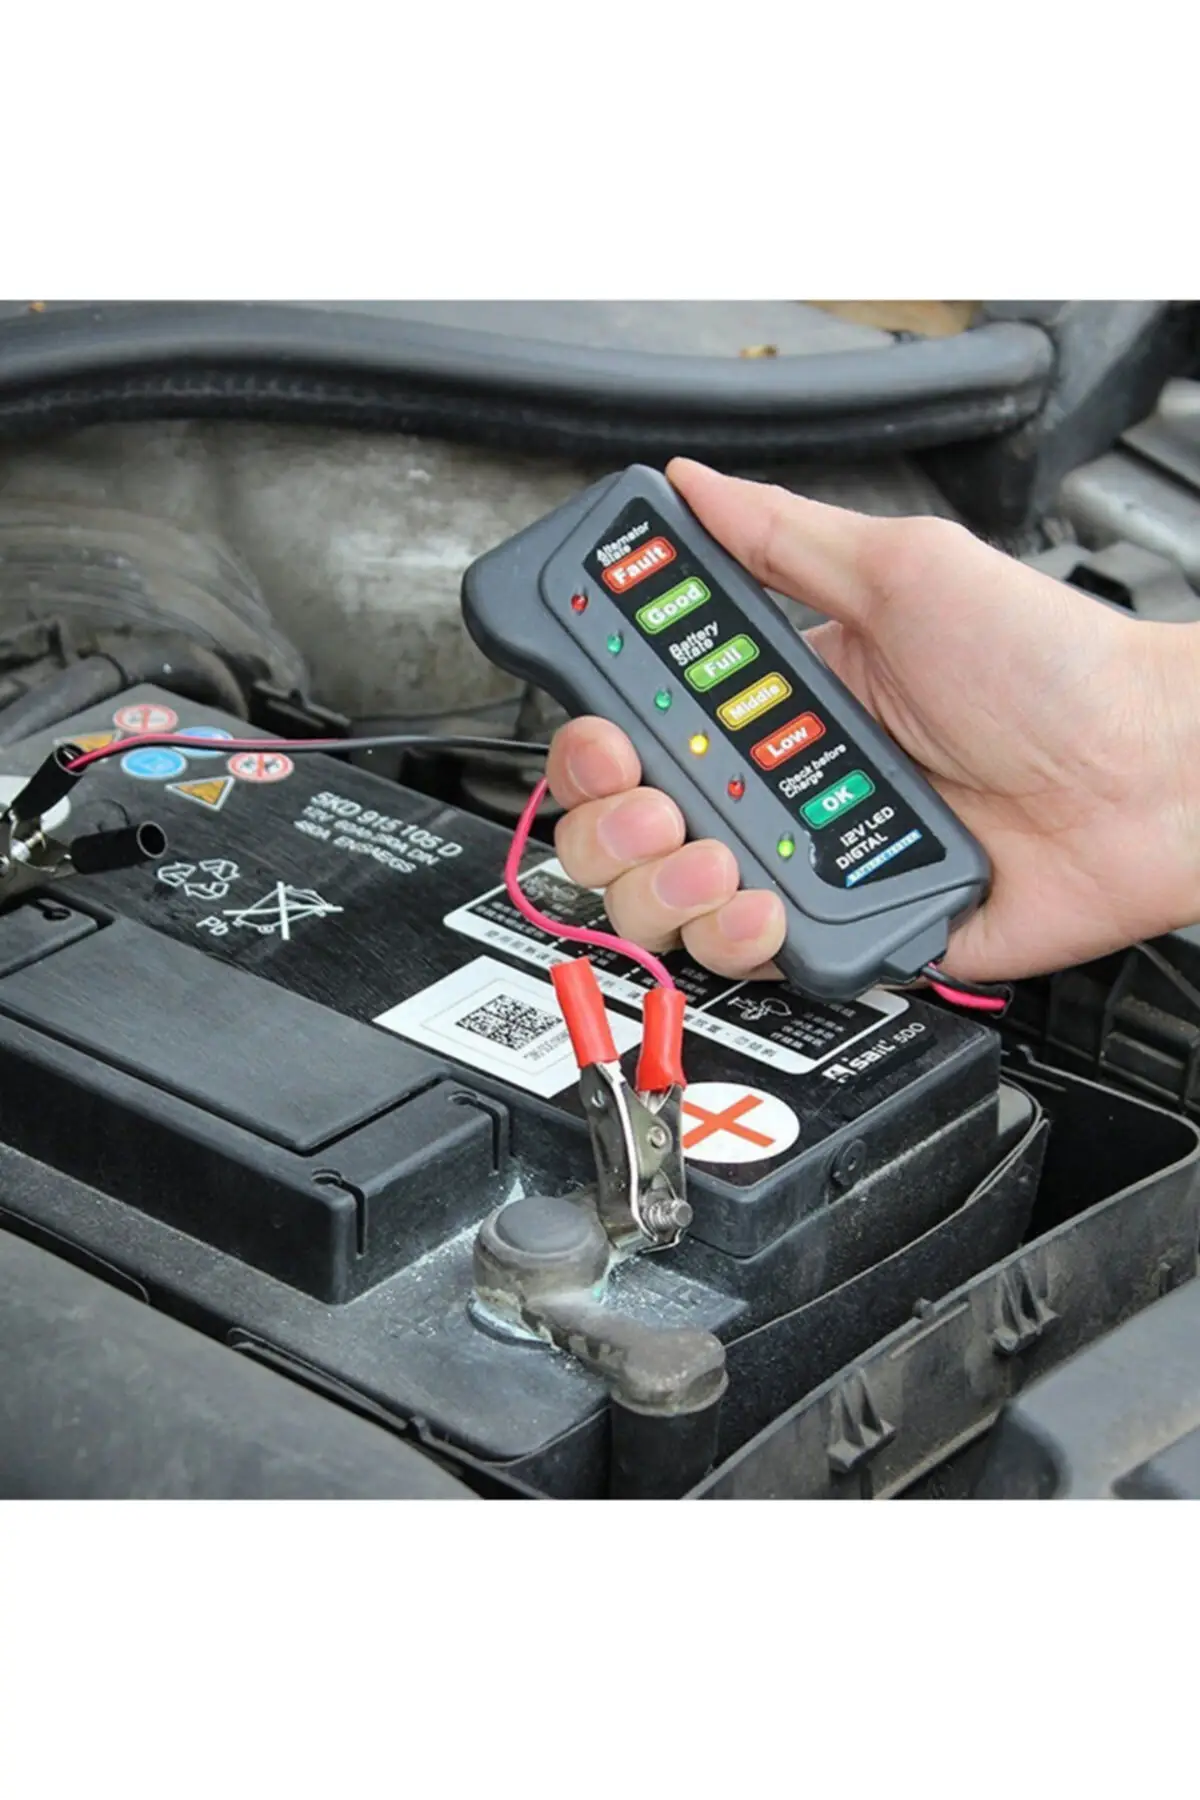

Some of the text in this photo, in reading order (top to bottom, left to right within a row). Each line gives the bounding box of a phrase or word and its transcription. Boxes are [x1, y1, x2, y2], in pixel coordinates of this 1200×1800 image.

[612, 547, 667, 585] Fault
[648, 583, 702, 625] Good
[669, 620, 719, 661] Battery
[703, 646, 742, 677] Full
[729, 685, 780, 720] Middle
[766, 726, 808, 758] Low
[779, 743, 847, 793] Check before
[784, 770, 824, 799] Charge
[822, 785, 855, 812] OK
[356, 810, 404, 833] 915
[400, 824, 445, 850] 105
[437, 842, 463, 858] D
[864, 806, 895, 829] LED
[835, 832, 888, 870] DIGTAL
[196, 915, 229, 936] Pb
